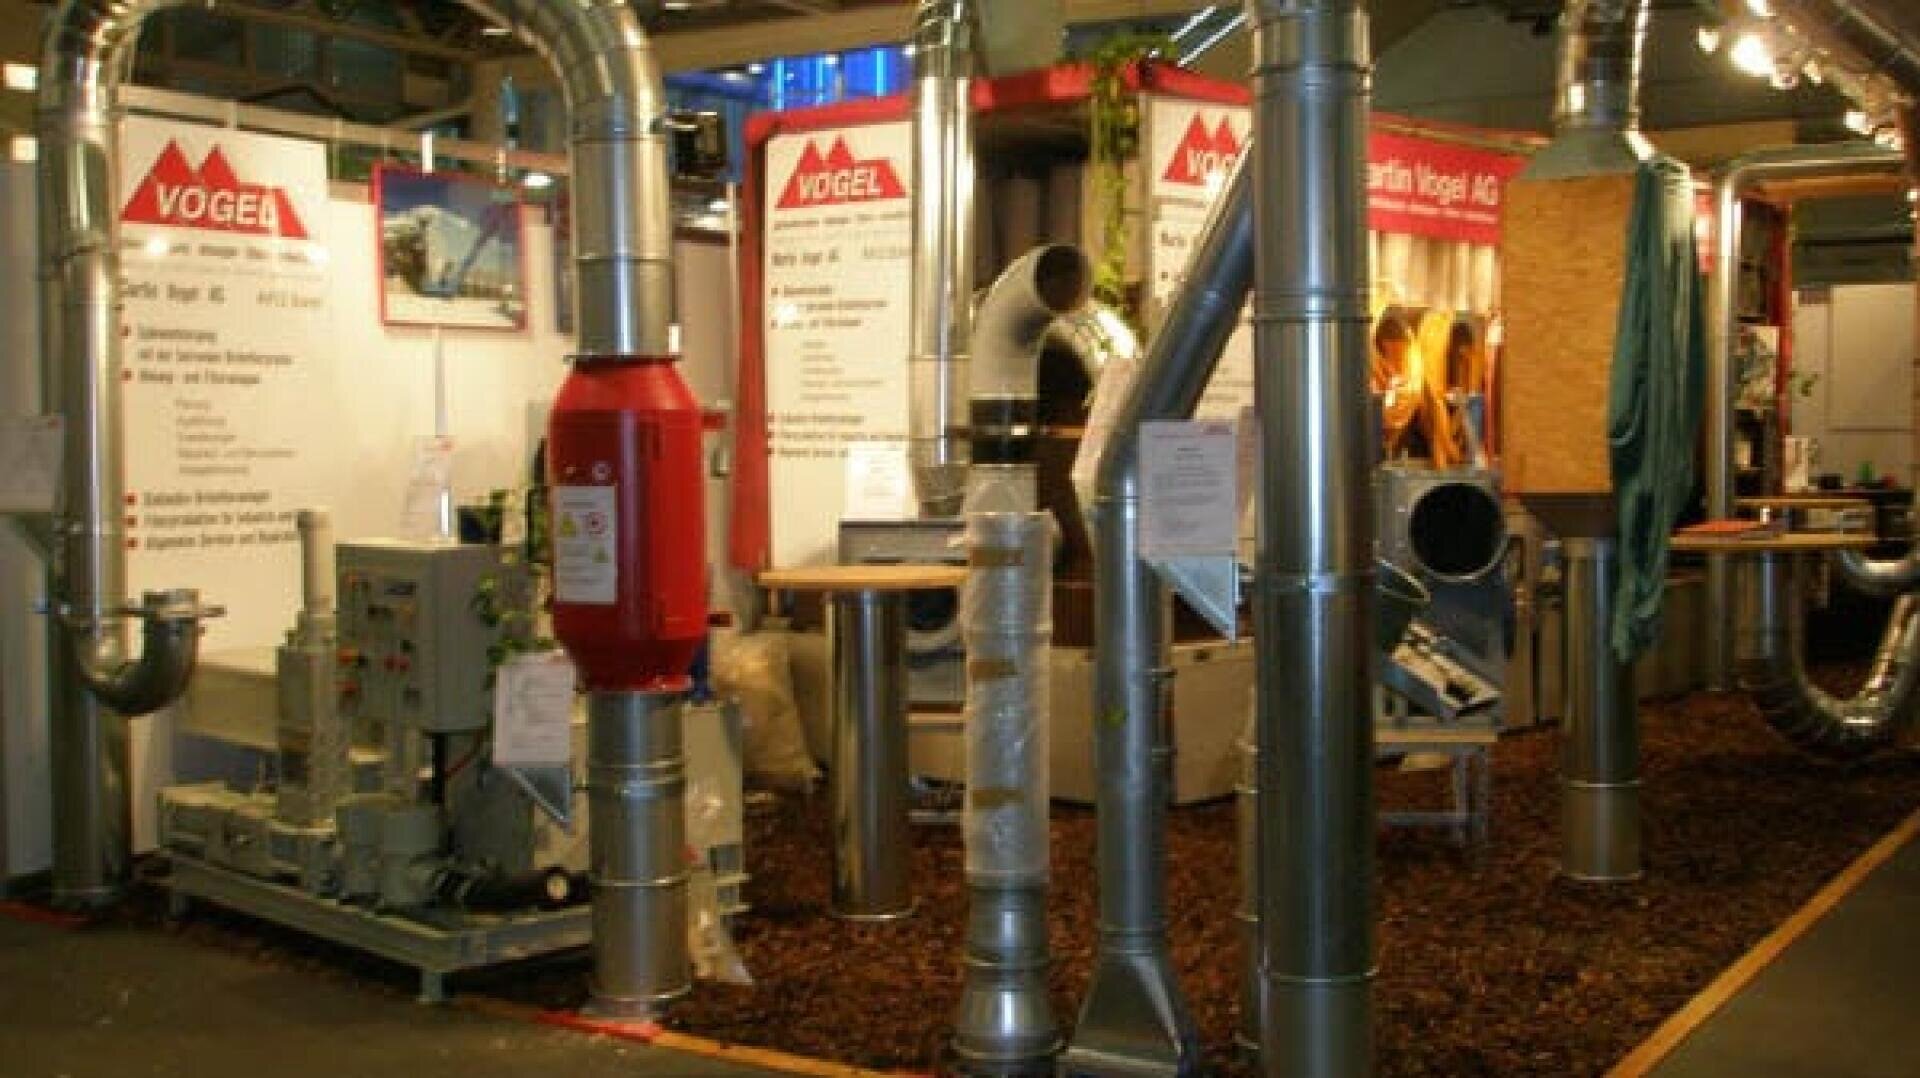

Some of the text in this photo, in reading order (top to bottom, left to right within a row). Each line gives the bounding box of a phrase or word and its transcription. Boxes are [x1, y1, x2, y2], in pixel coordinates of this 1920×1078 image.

[1187, 148, 1238, 177] VOG
[1367, 159, 1498, 205] artin Vogel AG
[797, 166, 881, 200] VOGEL
[156, 182, 278, 227] VOGEL
